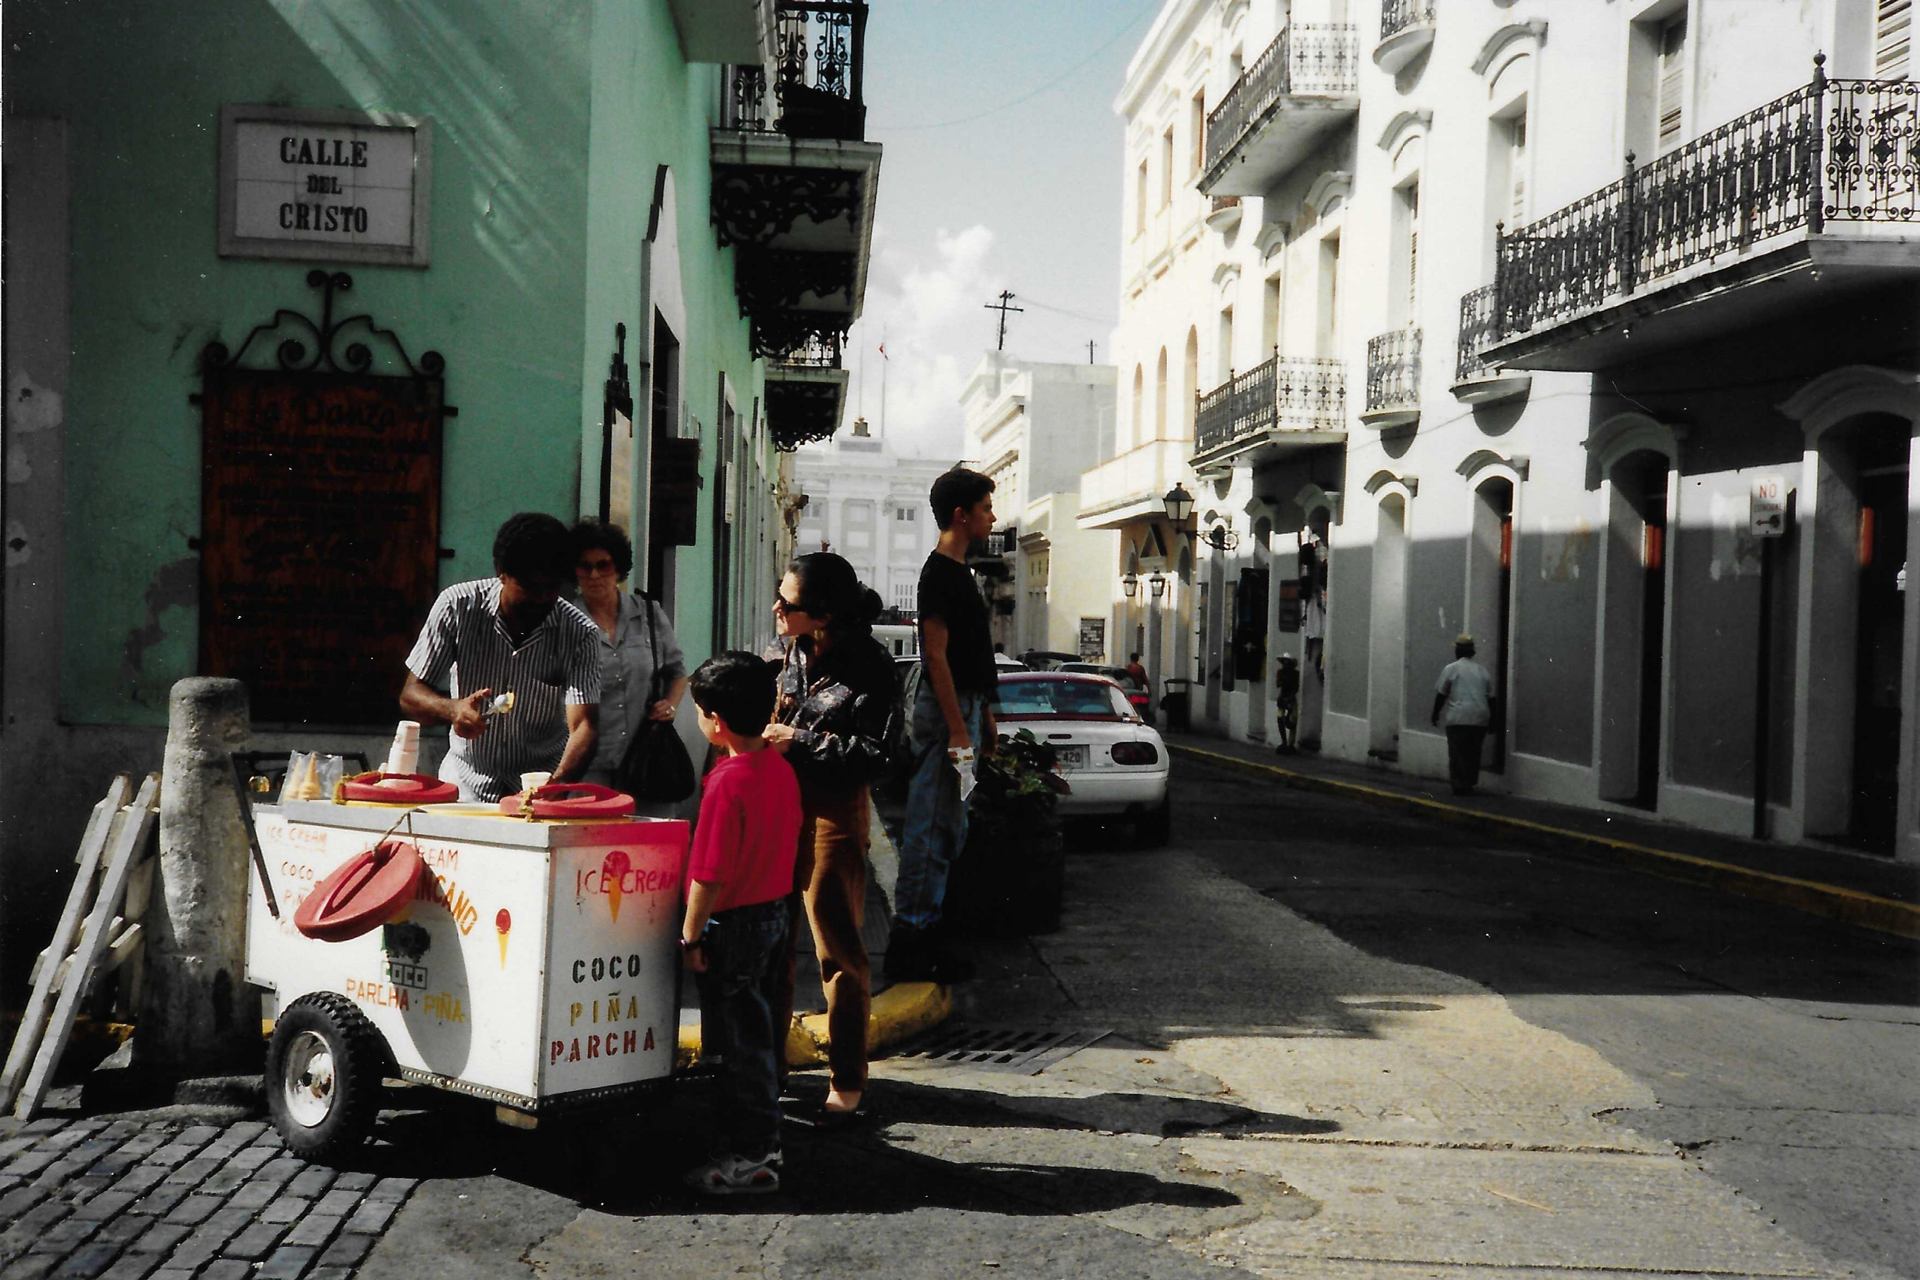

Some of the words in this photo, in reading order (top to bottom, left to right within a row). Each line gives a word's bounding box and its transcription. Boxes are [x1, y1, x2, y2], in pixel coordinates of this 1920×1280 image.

[280, 137, 367, 168] CALLE
[307, 173, 342, 195] DEL
[279, 203, 368, 233] CRISTO
[1759, 484, 1777, 498] NO
[281, 861, 314, 881] COCO
[576, 864, 612, 896] ICE
[572, 954, 641, 984] COCO
[423, 992, 464, 1023] PIÑA
[570, 990, 639, 1027] PIÑA
[550, 1027, 655, 1066] PARCHA
